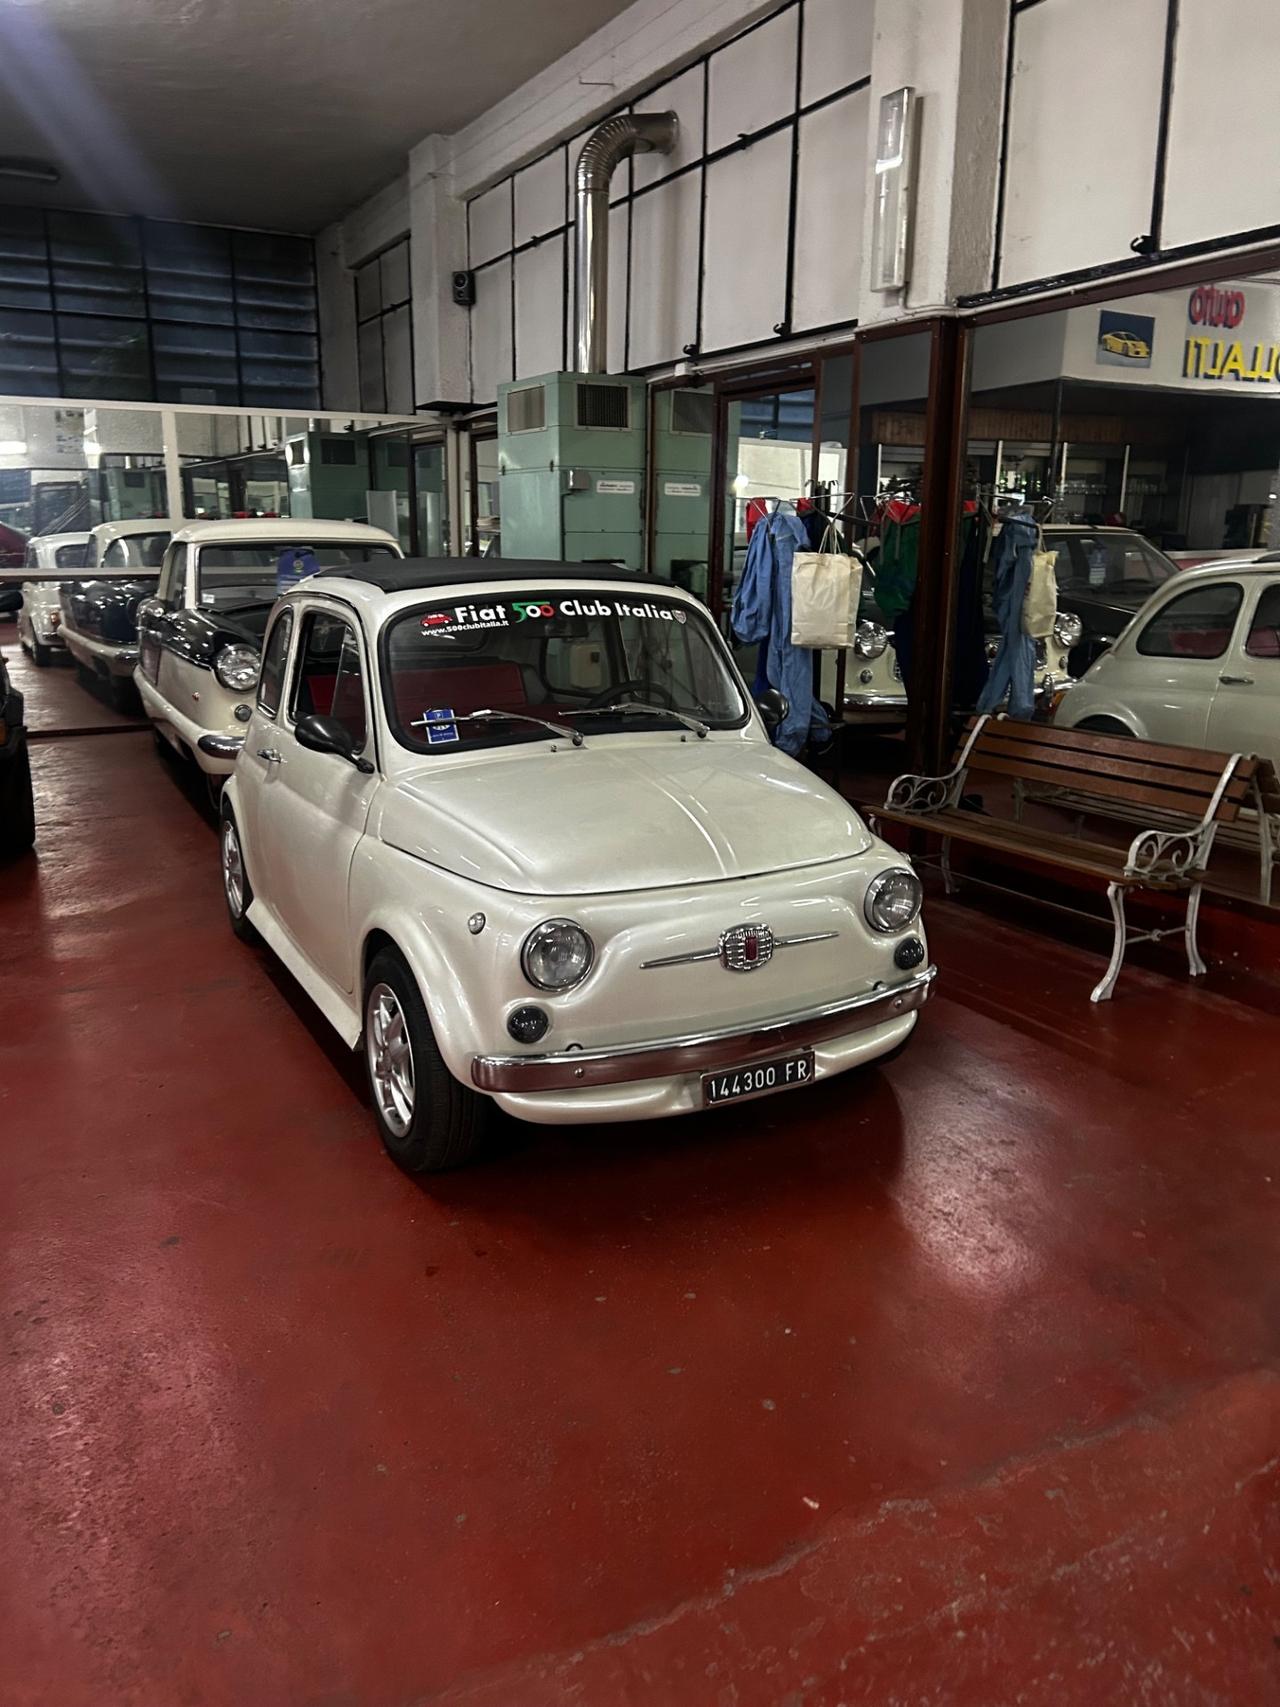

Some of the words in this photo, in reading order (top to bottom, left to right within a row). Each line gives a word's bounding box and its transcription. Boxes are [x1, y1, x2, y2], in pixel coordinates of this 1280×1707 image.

[454, 604, 507, 623] Fiat
[512, 601, 555, 624] 500
[559, 599, 612, 617] Club
[613, 602, 674, 621] Italia
[710, 1067, 776, 1099] 144300
[785, 1060, 808, 1082] FR
